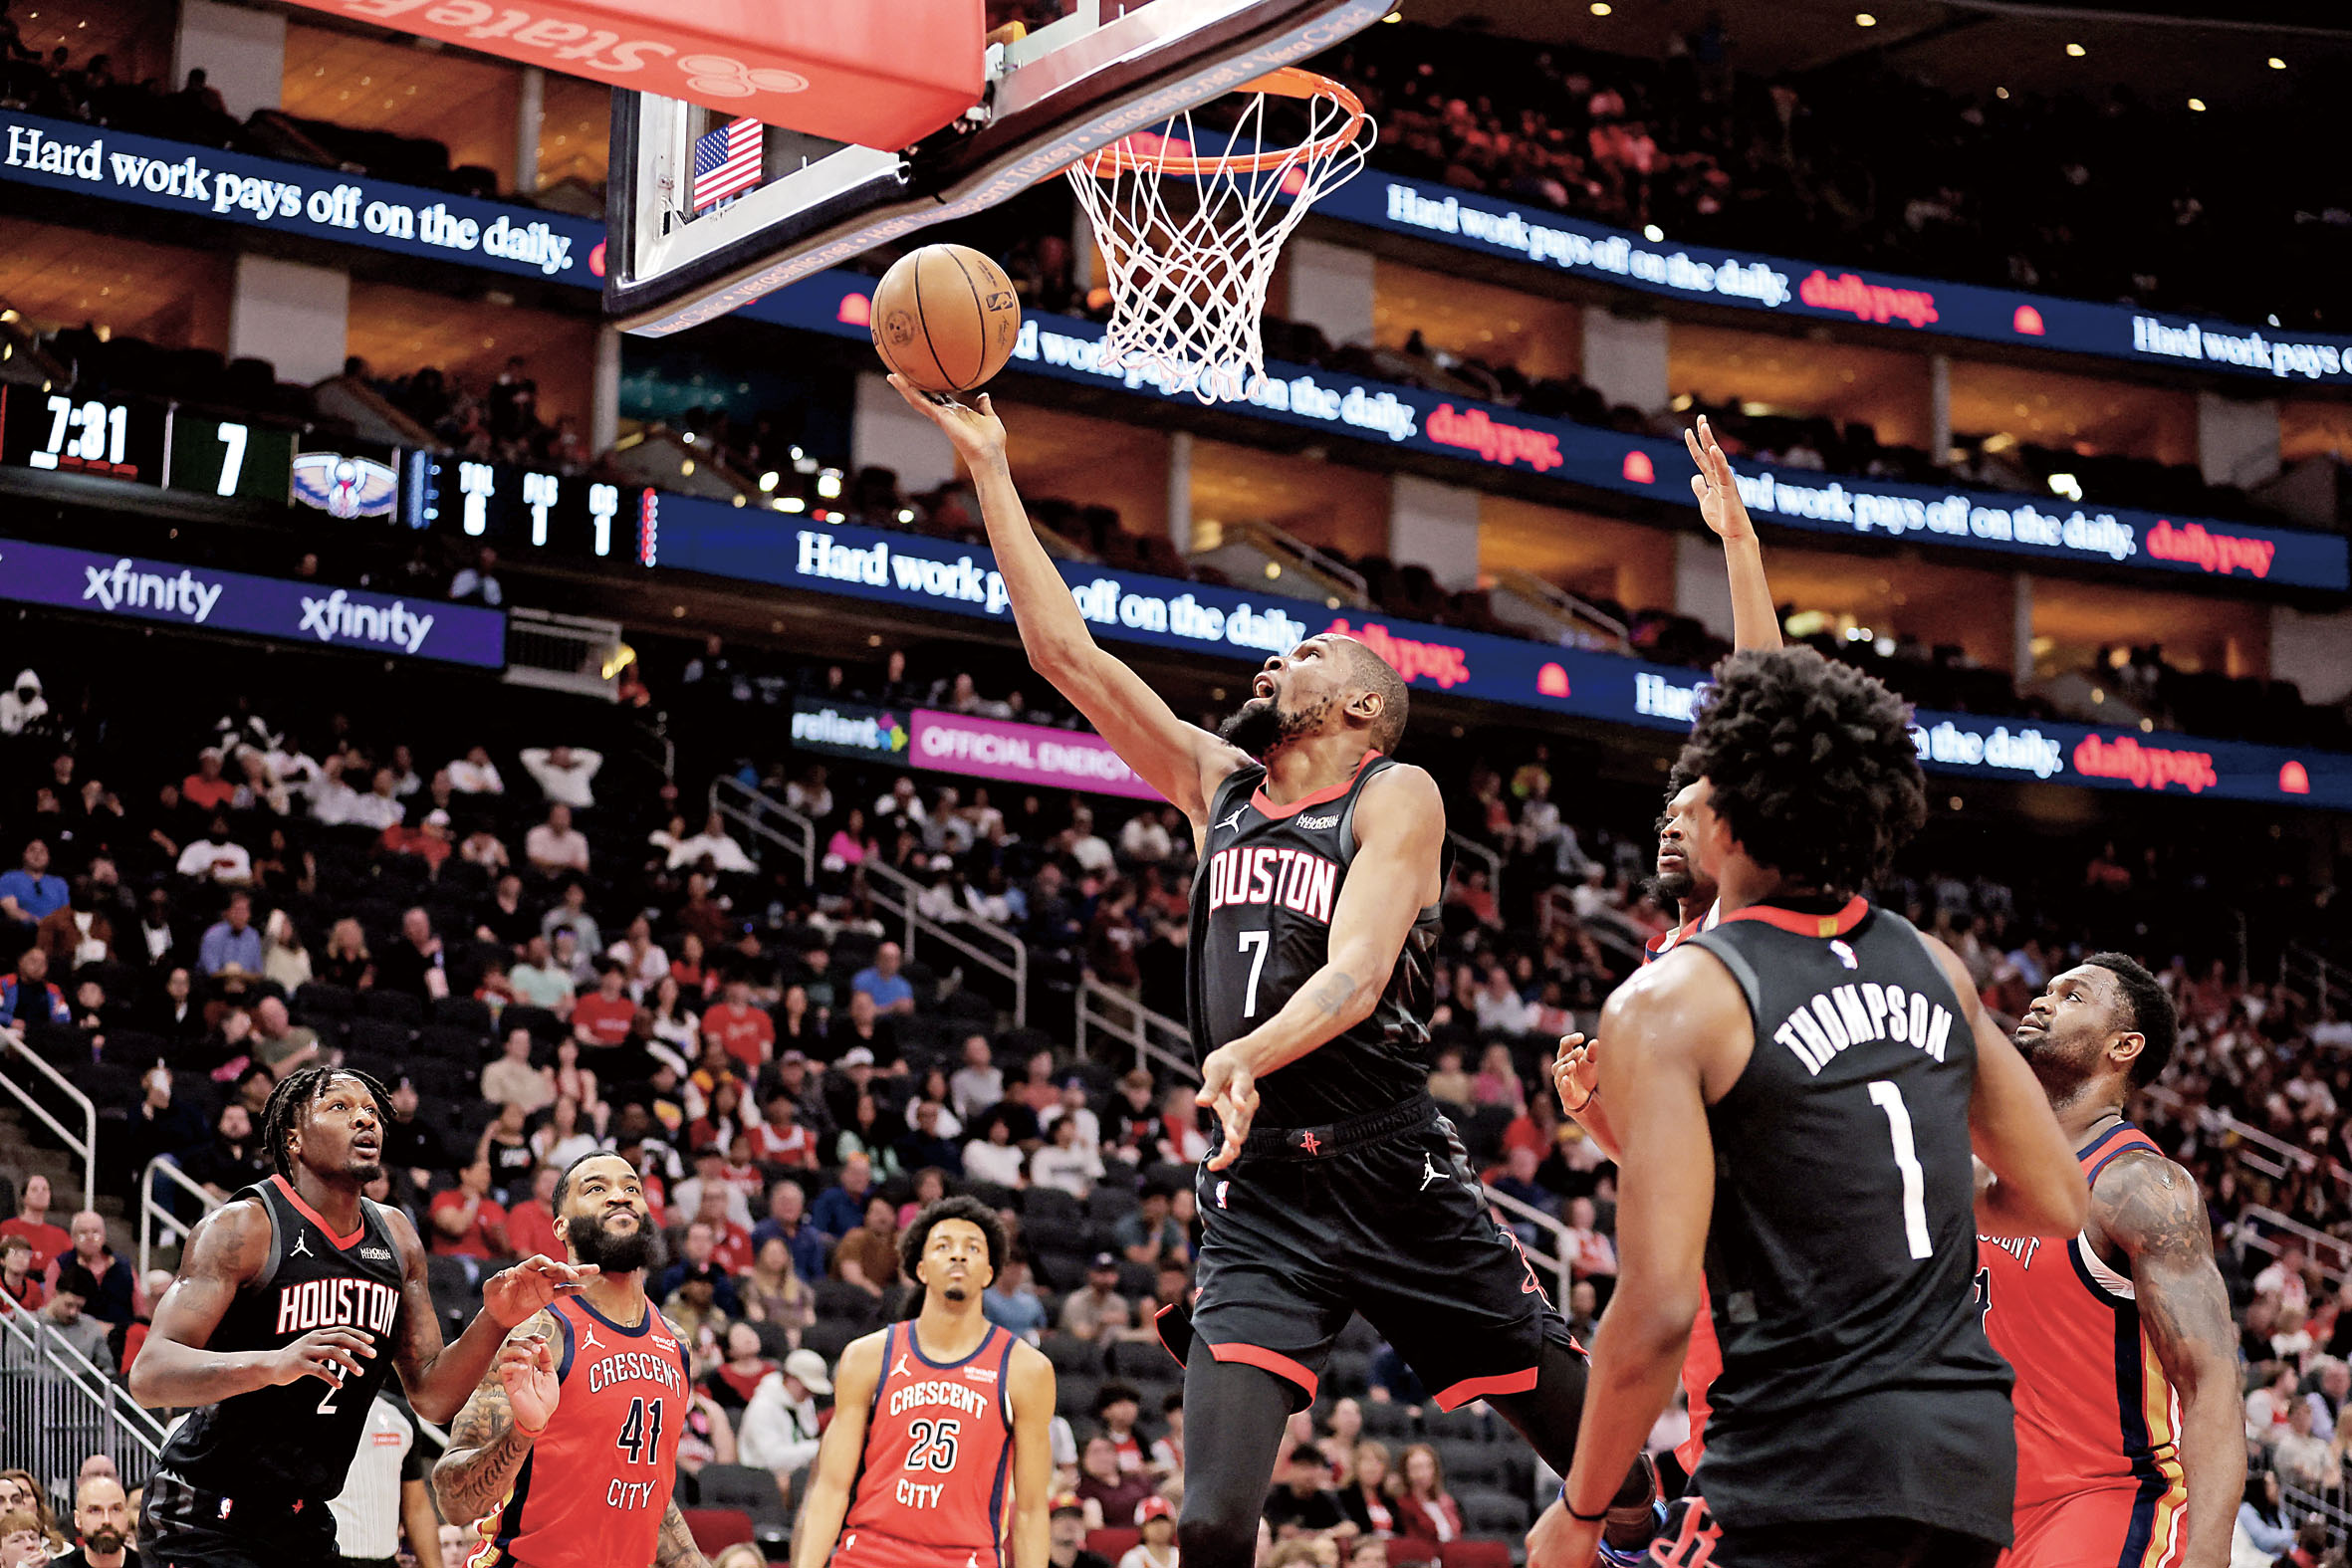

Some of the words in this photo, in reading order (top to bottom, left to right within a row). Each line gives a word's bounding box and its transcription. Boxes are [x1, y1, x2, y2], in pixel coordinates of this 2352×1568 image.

[1010, 142, 1086, 180] Turkey
[4, 125, 103, 181] Hard
[109, 152, 210, 201] work
[212, 172, 301, 221] pays
[307, 184, 361, 229] off
[363, 201, 414, 240] on
[417, 203, 479, 251] the
[483, 216, 574, 275] daily.
[217, 421, 248, 497] 7
[83, 558, 223, 623] xfinity
[796, 530, 890, 587] Hard
[890, 554, 987, 603] work
[299, 588, 434, 654] xfinity
[1070, 577, 1121, 625] off
[1119, 593, 1168, 633] on
[1168, 593, 1226, 642] the
[792, 708, 880, 751] reliant
[921, 726, 1036, 770] OFFICIAL
[1208, 846, 1338, 925] OUSTON
[1238, 930, 1270, 1017] 7
[1773, 983, 1953, 1076] THOMPSON
[1867, 1080, 1934, 1260] 1
[275, 1277, 400, 1339] HOUSTON
[588, 1351, 681, 1400] CRESCENT
[889, 1380, 989, 1421] CRESCENT
[616, 1396, 663, 1465] 41
[903, 1417, 962, 1474] 25
[605, 1477, 657, 1511] CITY
[894, 1477, 945, 1510] CITY
